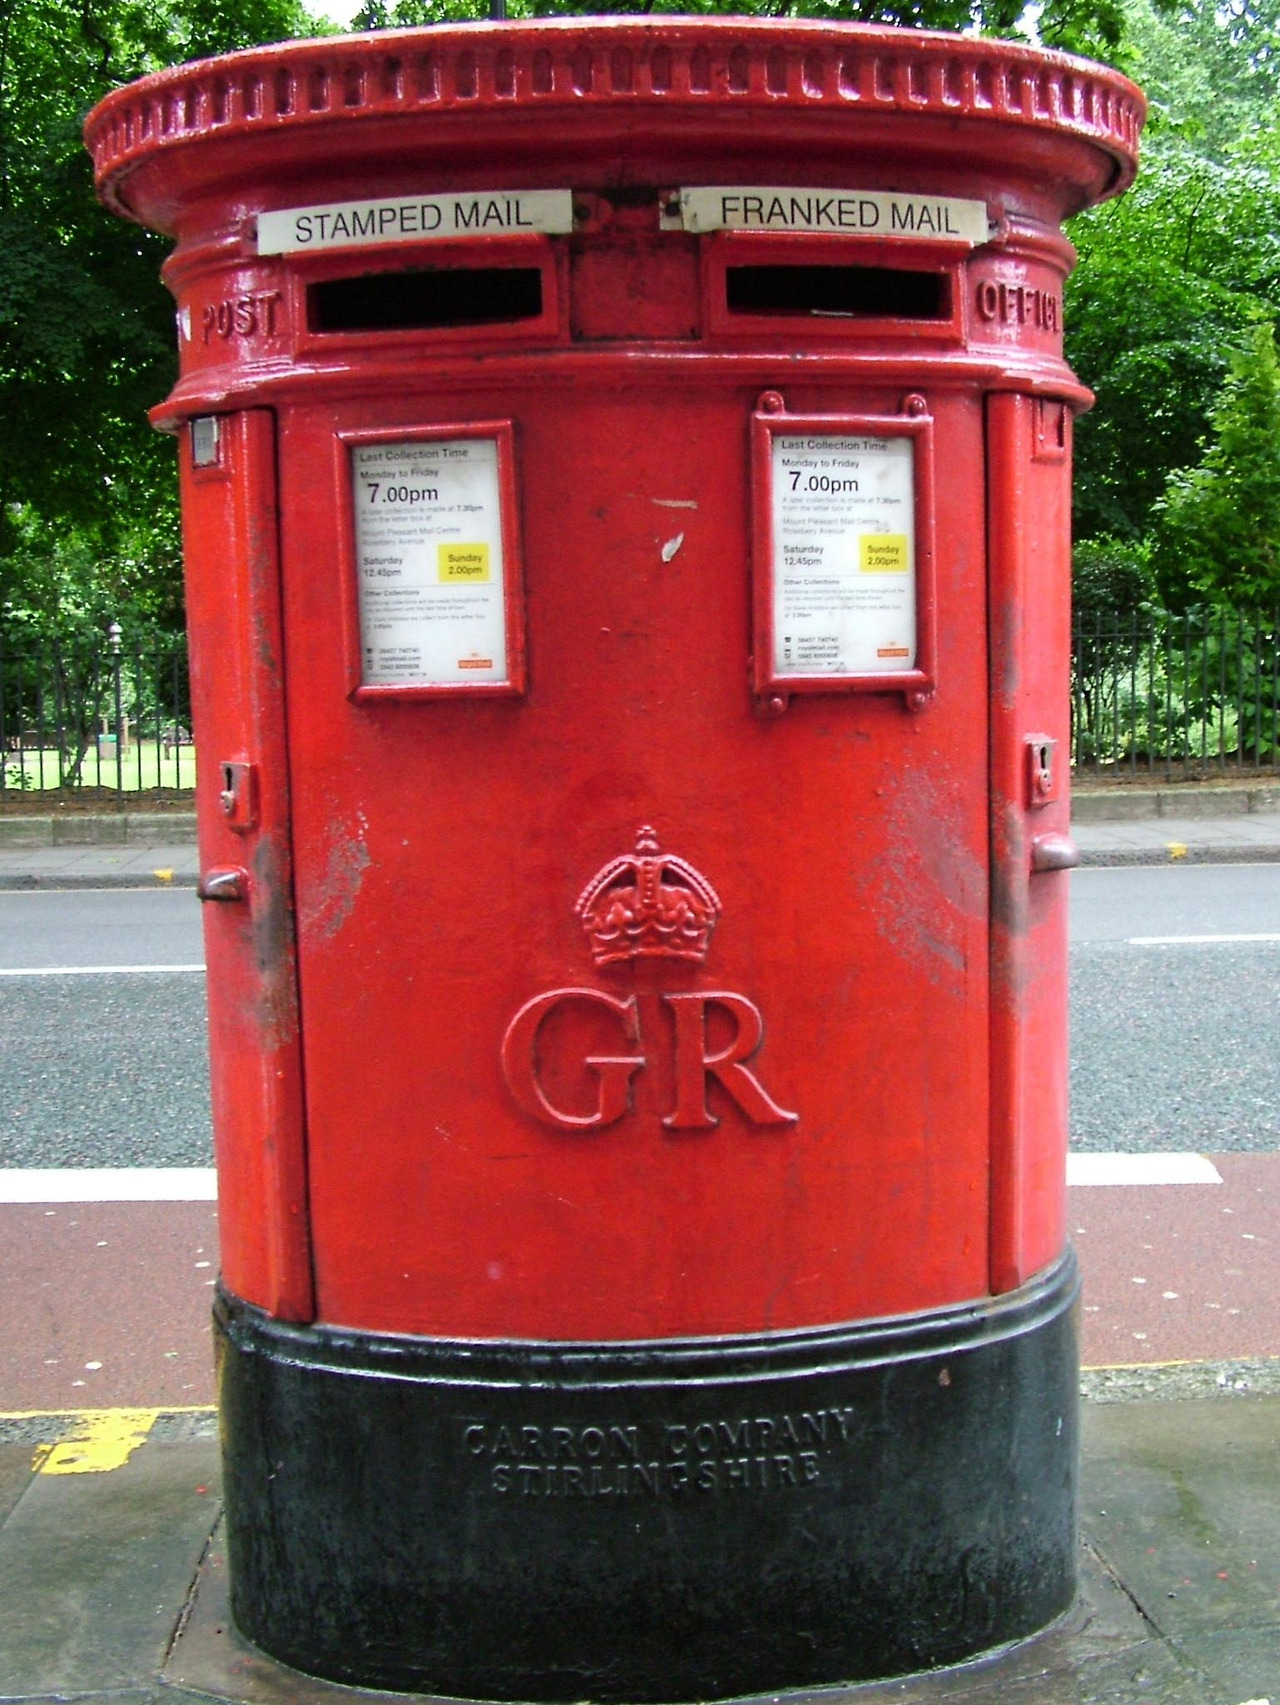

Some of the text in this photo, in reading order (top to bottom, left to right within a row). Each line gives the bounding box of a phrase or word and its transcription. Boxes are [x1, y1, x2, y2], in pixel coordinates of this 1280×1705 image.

[295, 200, 533, 243] STAMPED MAIL
[722, 196, 960, 234] FRANKED MAIL
[201, 289, 282, 345] POST
[781, 440, 888, 452] Last Collection Time
[360, 448, 469, 463] Last Collection Time
[782, 459, 860, 469] Monday to Friday
[360, 468, 439, 480] Monday to Friday
[789, 471, 859, 495] 7.00pm
[367, 483, 438, 505] 7.00pm
[448, 554, 482, 564] Sunday
[783, 545, 824, 555] Saturday
[867, 545, 900, 555] Sunday
[363, 556, 403, 567] Saturday
[500, 986, 800, 1129] GR
[465, 1406, 854, 1459] CARRON COMPANY
[492, 1451, 820, 1496] STIRLINGSHIRE
